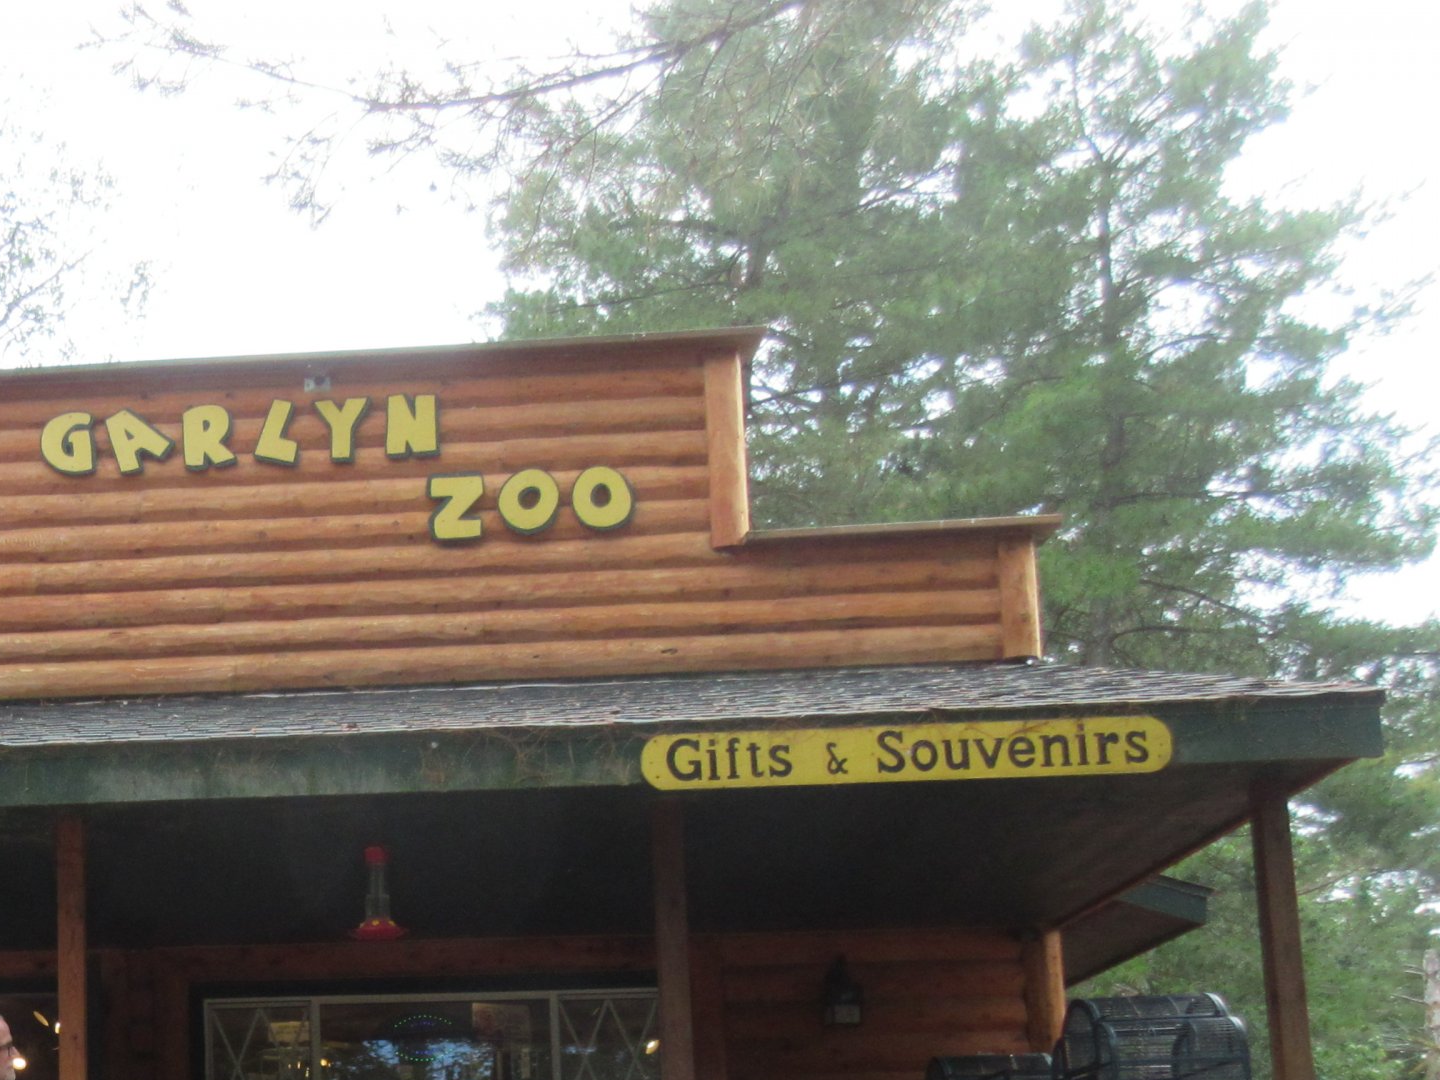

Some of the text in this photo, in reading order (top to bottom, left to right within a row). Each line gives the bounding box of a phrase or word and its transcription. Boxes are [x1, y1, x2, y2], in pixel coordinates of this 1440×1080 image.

[40, 394, 440, 475] GARLYN
[427, 465, 635, 542] ZOO
[666, 724, 1150, 783] Gifts & Souvenirs
